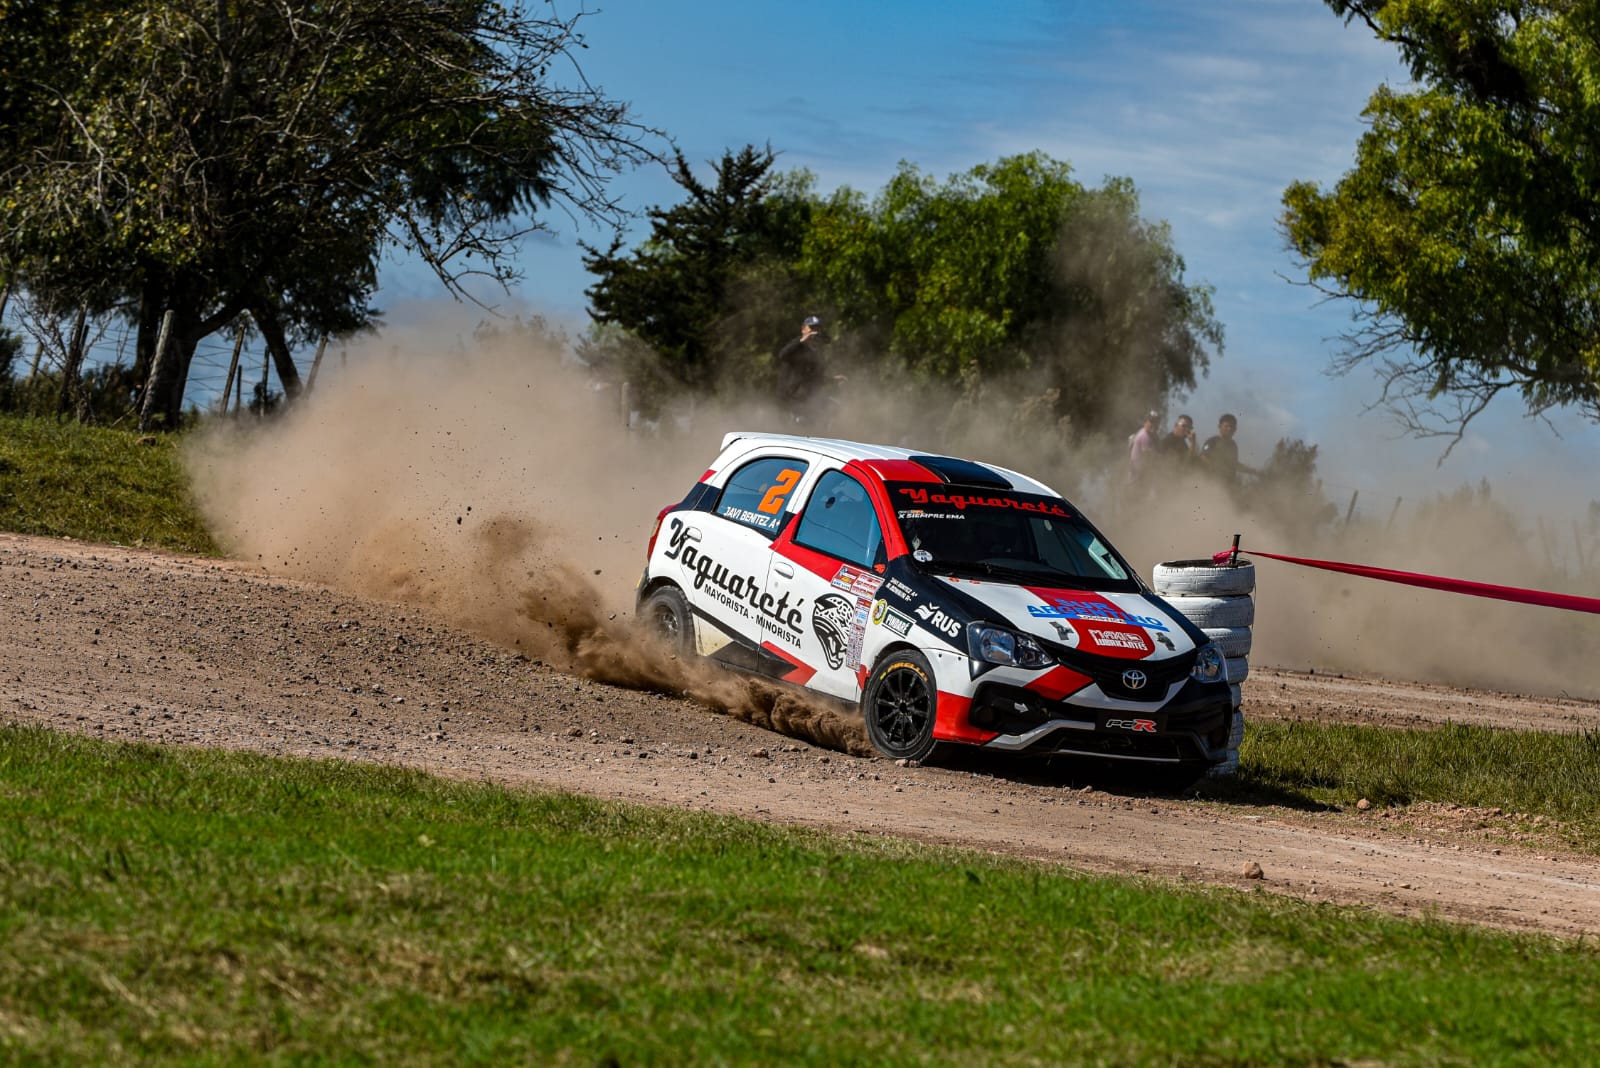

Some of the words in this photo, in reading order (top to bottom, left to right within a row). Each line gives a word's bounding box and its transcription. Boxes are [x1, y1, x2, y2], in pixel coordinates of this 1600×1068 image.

[757, 469, 802, 514] 2
[898, 488, 1071, 518] Yaguareté
[723, 506, 741, 519] JAVI
[740, 510, 770, 526] BENITEZ
[664, 517, 804, 635] Yaguareté
[704, 584, 749, 619] MAYORISTA
[755, 614, 802, 649] MINORISTA
[1027, 605, 1163, 626] ARGENTINO
[1055, 598, 1112, 609] SUR
[931, 610, 961, 638] RUS
[1106, 719, 1156, 732] PCR
